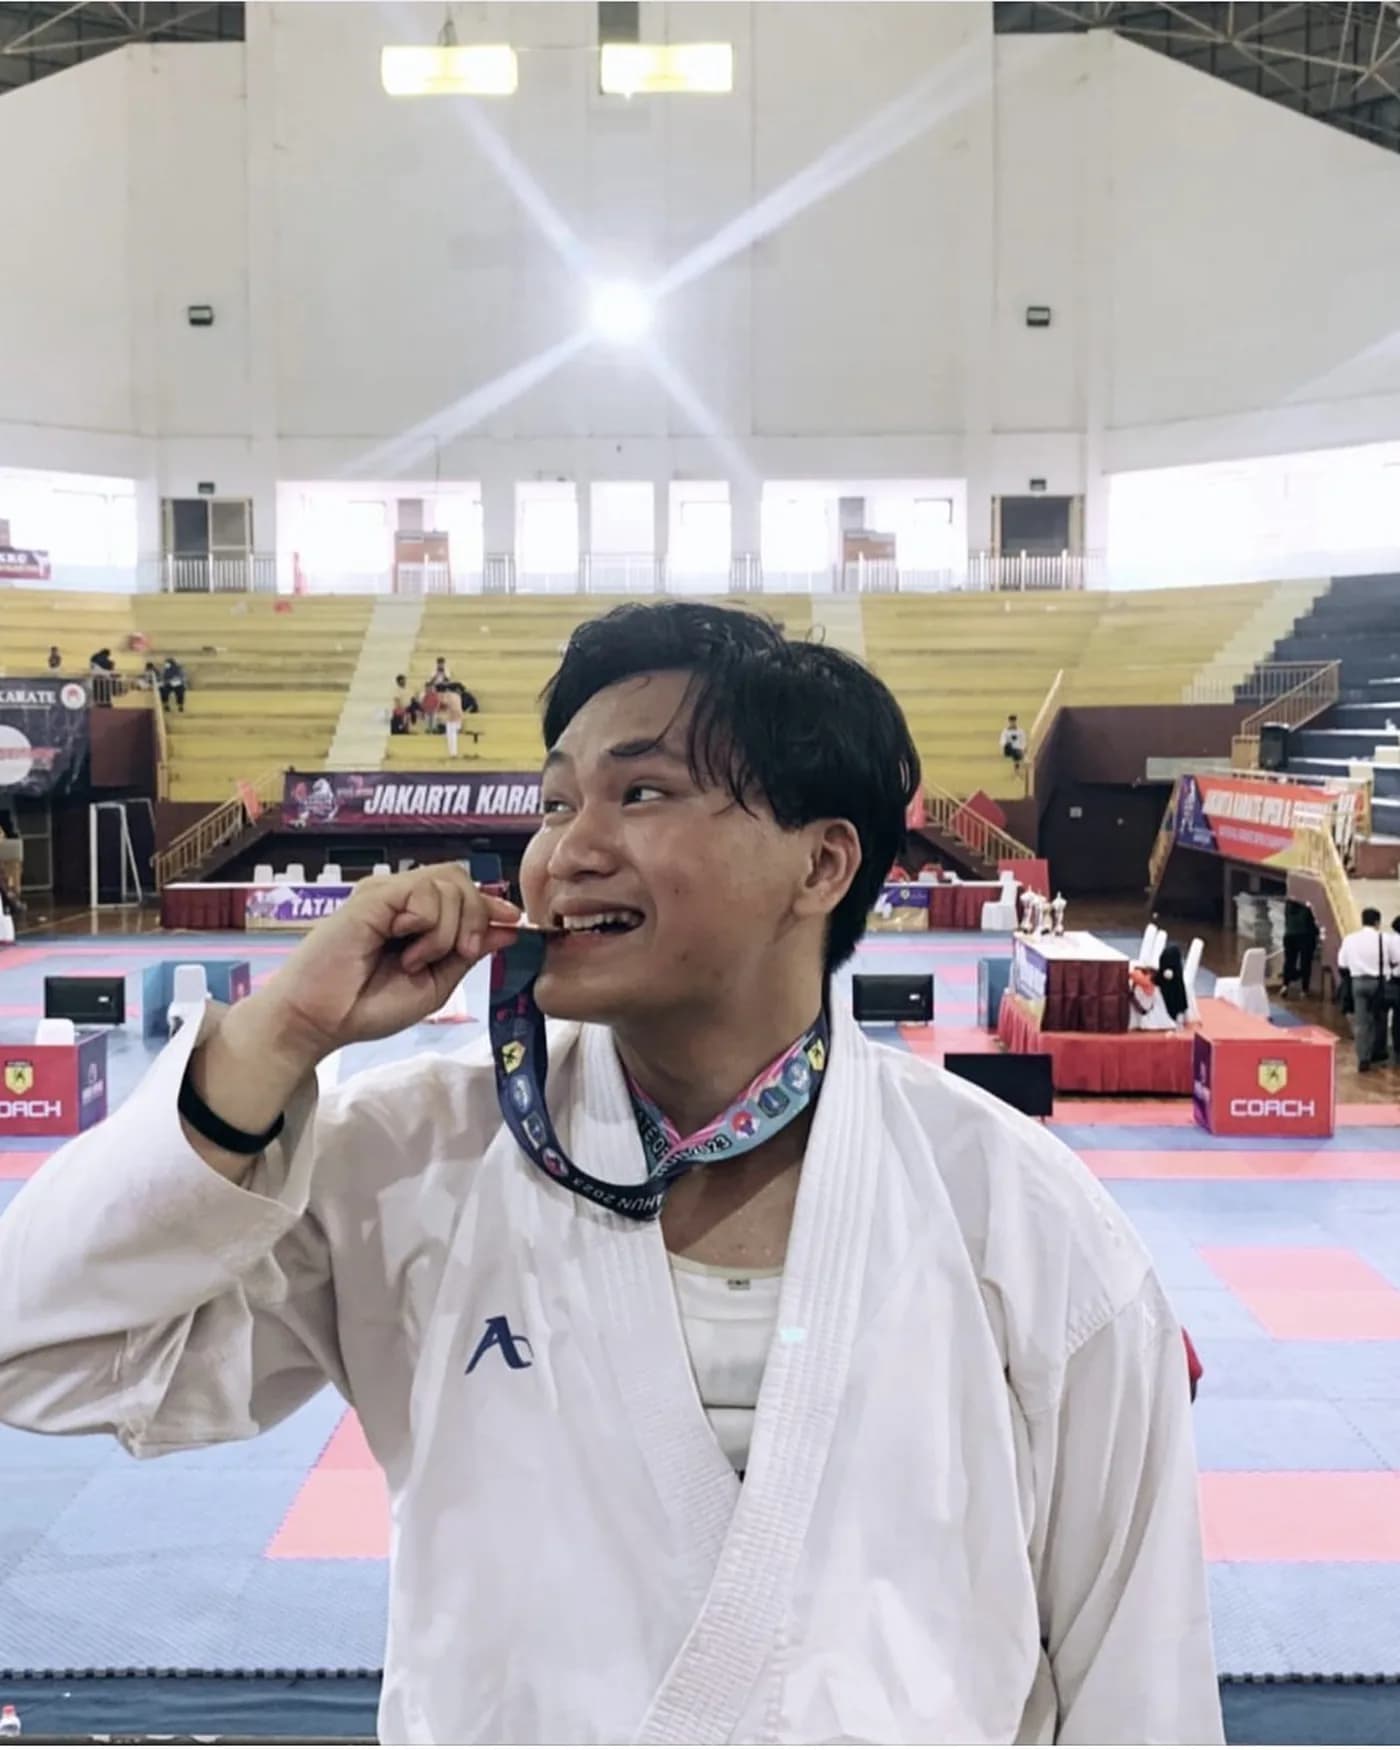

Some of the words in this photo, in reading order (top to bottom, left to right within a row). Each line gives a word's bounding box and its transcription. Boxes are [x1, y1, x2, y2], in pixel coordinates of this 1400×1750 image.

[363, 784, 471, 815] JAKARTA
[475, 785, 545, 815] KARA
[1230, 1099, 1315, 1117] COACH
